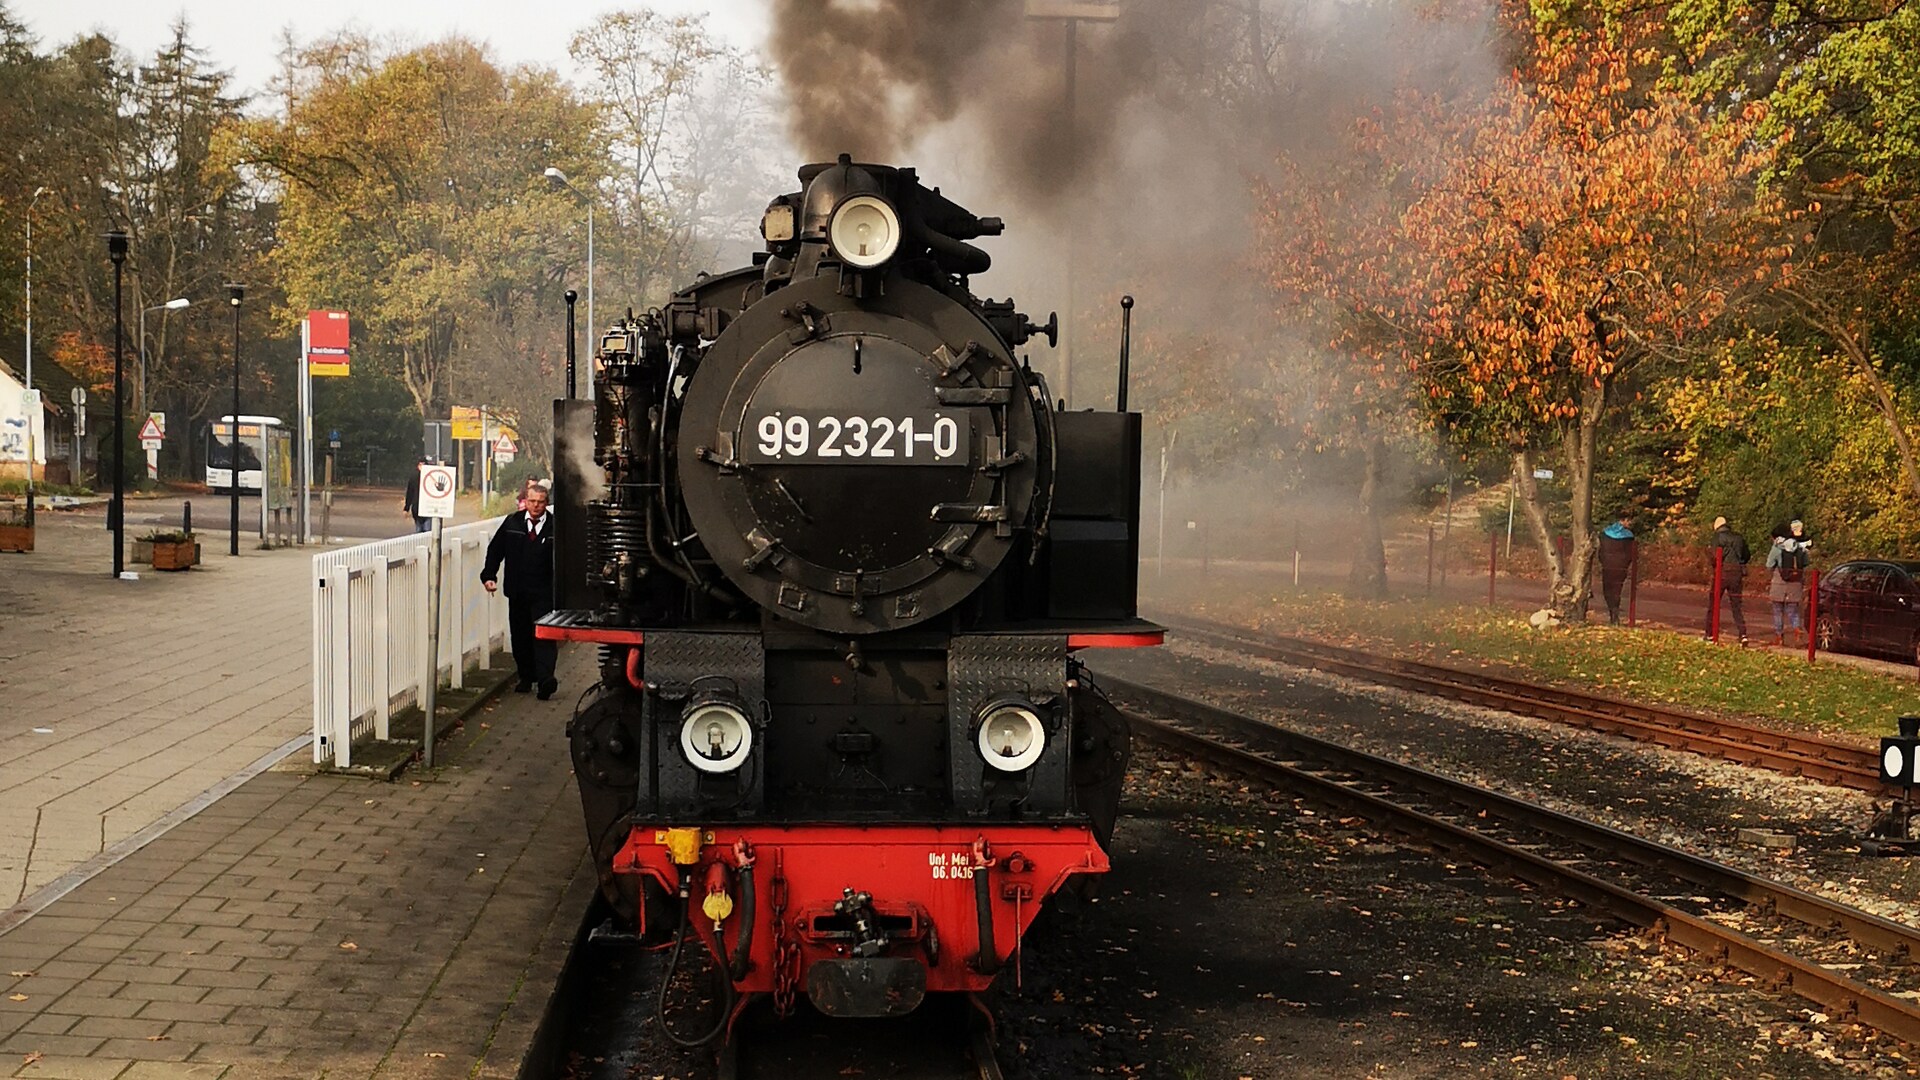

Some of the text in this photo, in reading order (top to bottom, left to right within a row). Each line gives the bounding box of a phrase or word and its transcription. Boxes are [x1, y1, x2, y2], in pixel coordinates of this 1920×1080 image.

[758, 416, 958, 458] 99 2321-0
[951, 852, 969, 866] Mei
